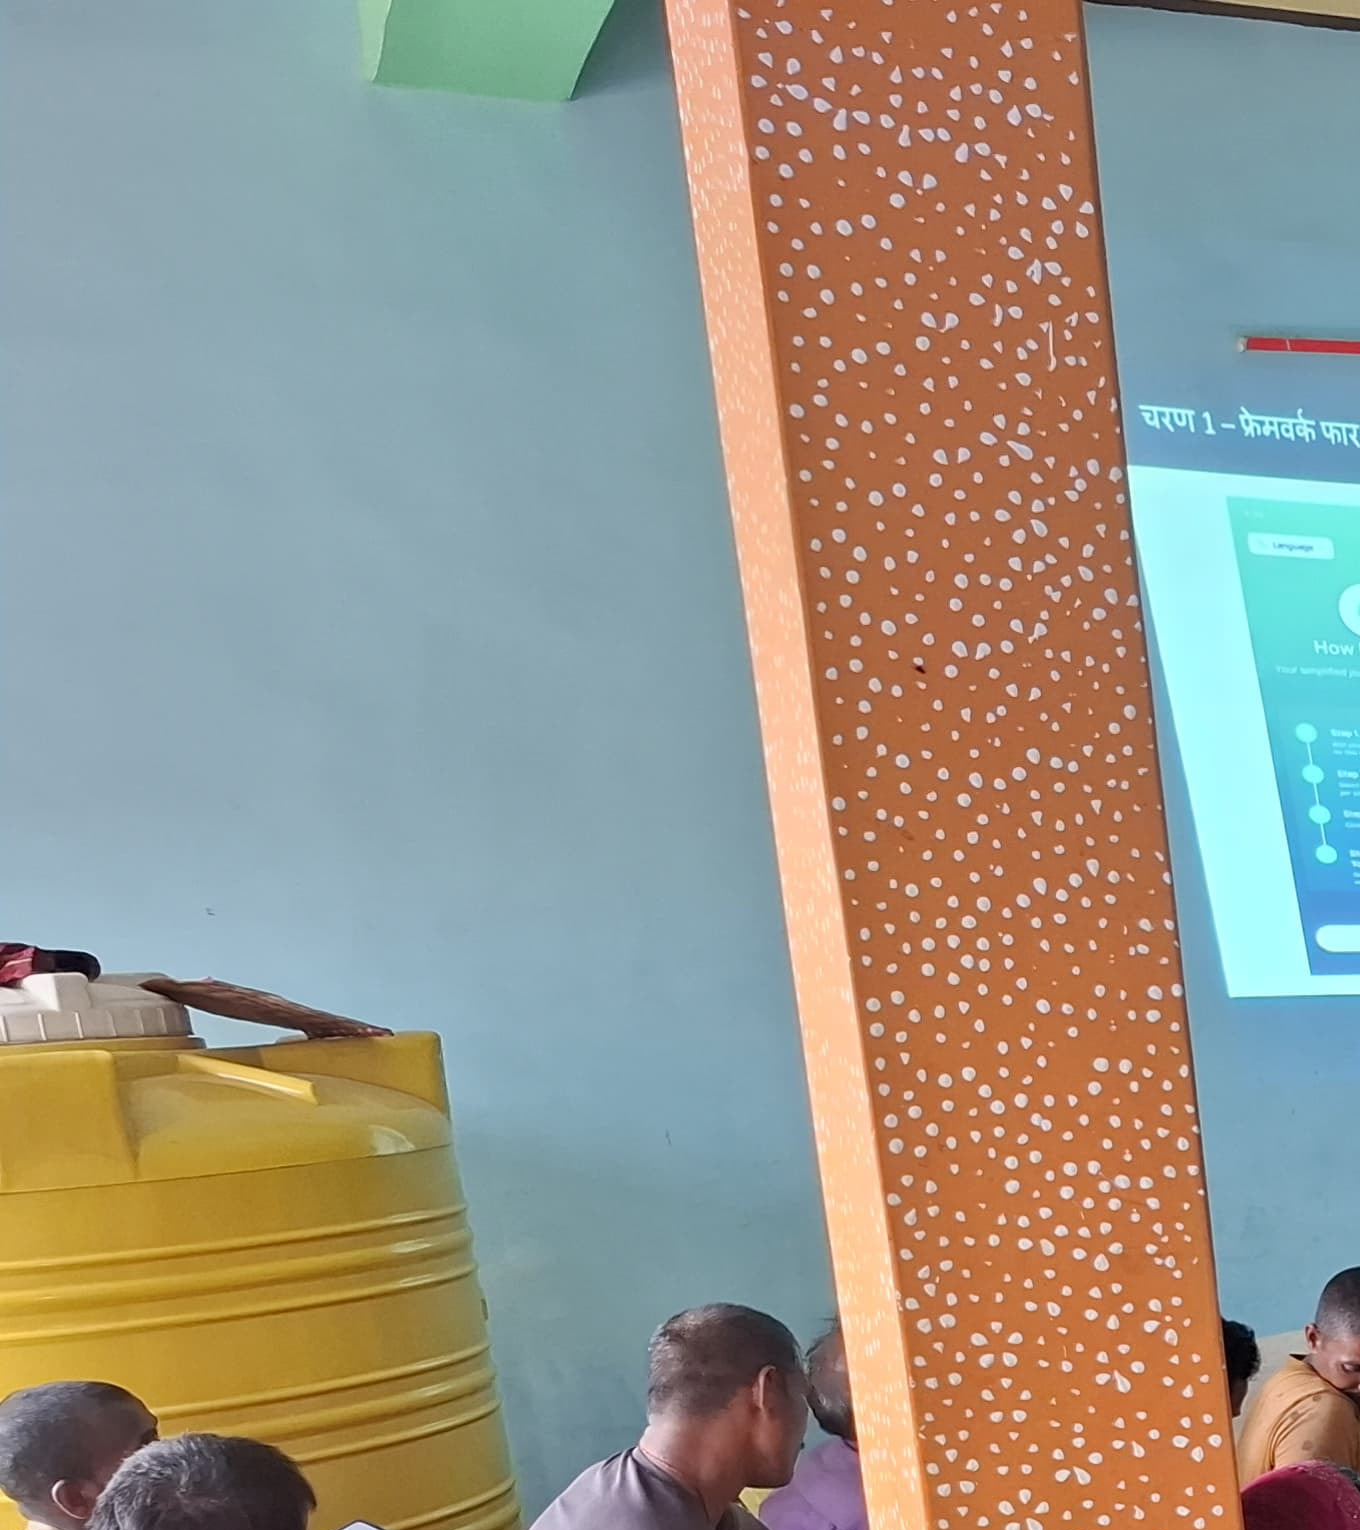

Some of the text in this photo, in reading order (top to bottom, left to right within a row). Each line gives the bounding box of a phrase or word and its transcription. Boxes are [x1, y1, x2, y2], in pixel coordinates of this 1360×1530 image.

[1138, 404, 1195, 432] चरण
[1202, 410, 1216, 435] 1
[1238, 406, 1316, 442] फ्रेमवर्क
[1319, 421, 1360, 448] फार
[1272, 541, 1314, 553] Language
[1313, 639, 1354, 656] How
